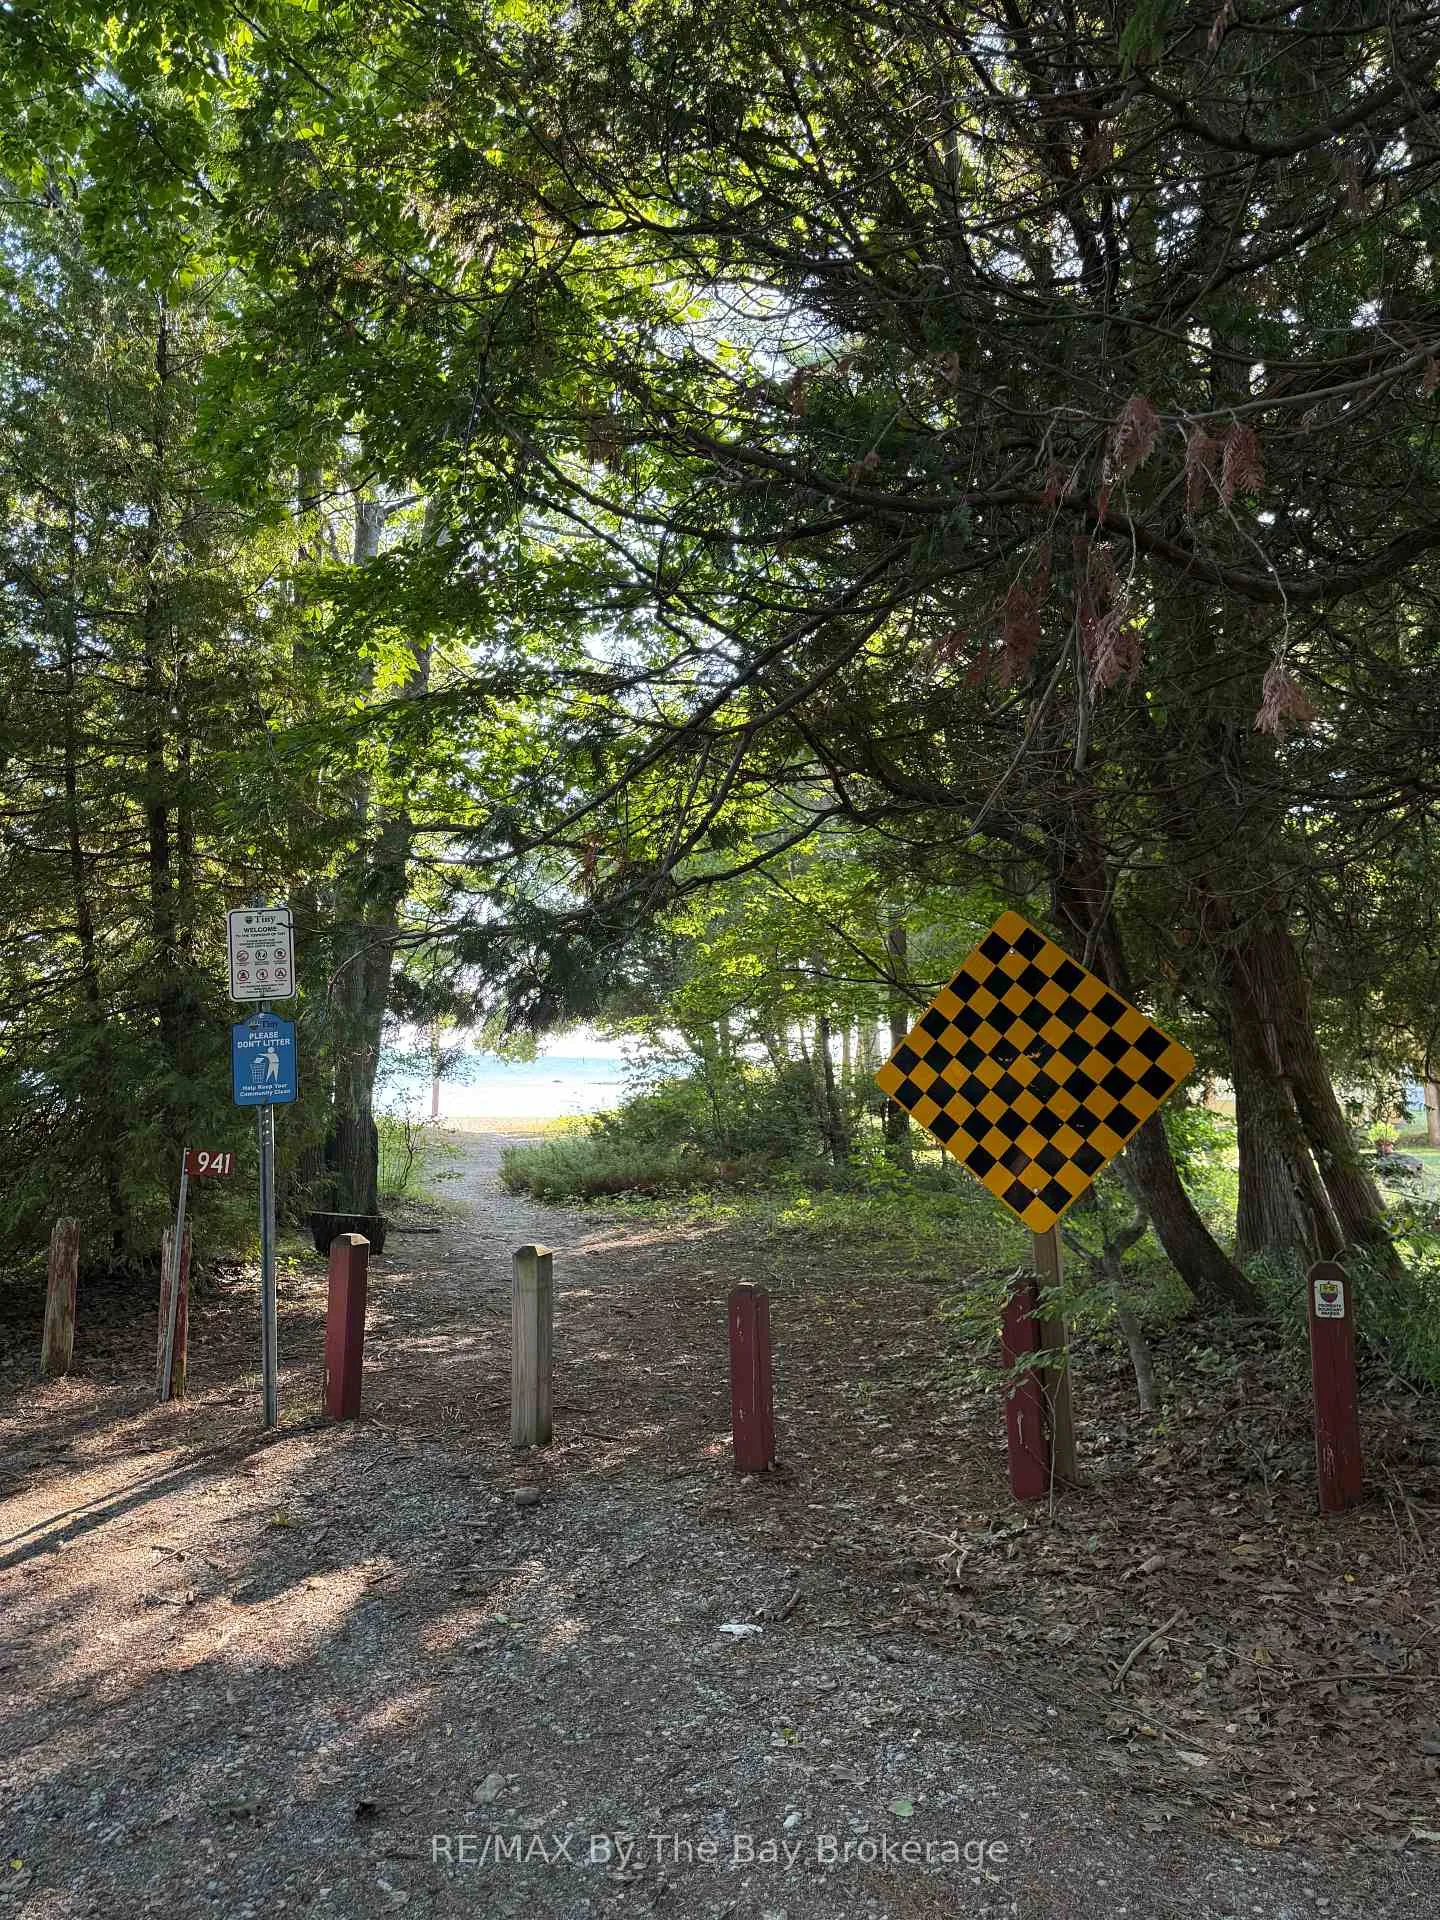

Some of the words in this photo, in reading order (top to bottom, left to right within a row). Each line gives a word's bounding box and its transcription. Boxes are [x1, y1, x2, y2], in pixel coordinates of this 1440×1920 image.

[237, 1039, 261, 1048] DON'T
[263, 1038, 290, 1047] LITTER
[239, 1089, 273, 1097] Community
[198, 1152, 231, 1174] 941
